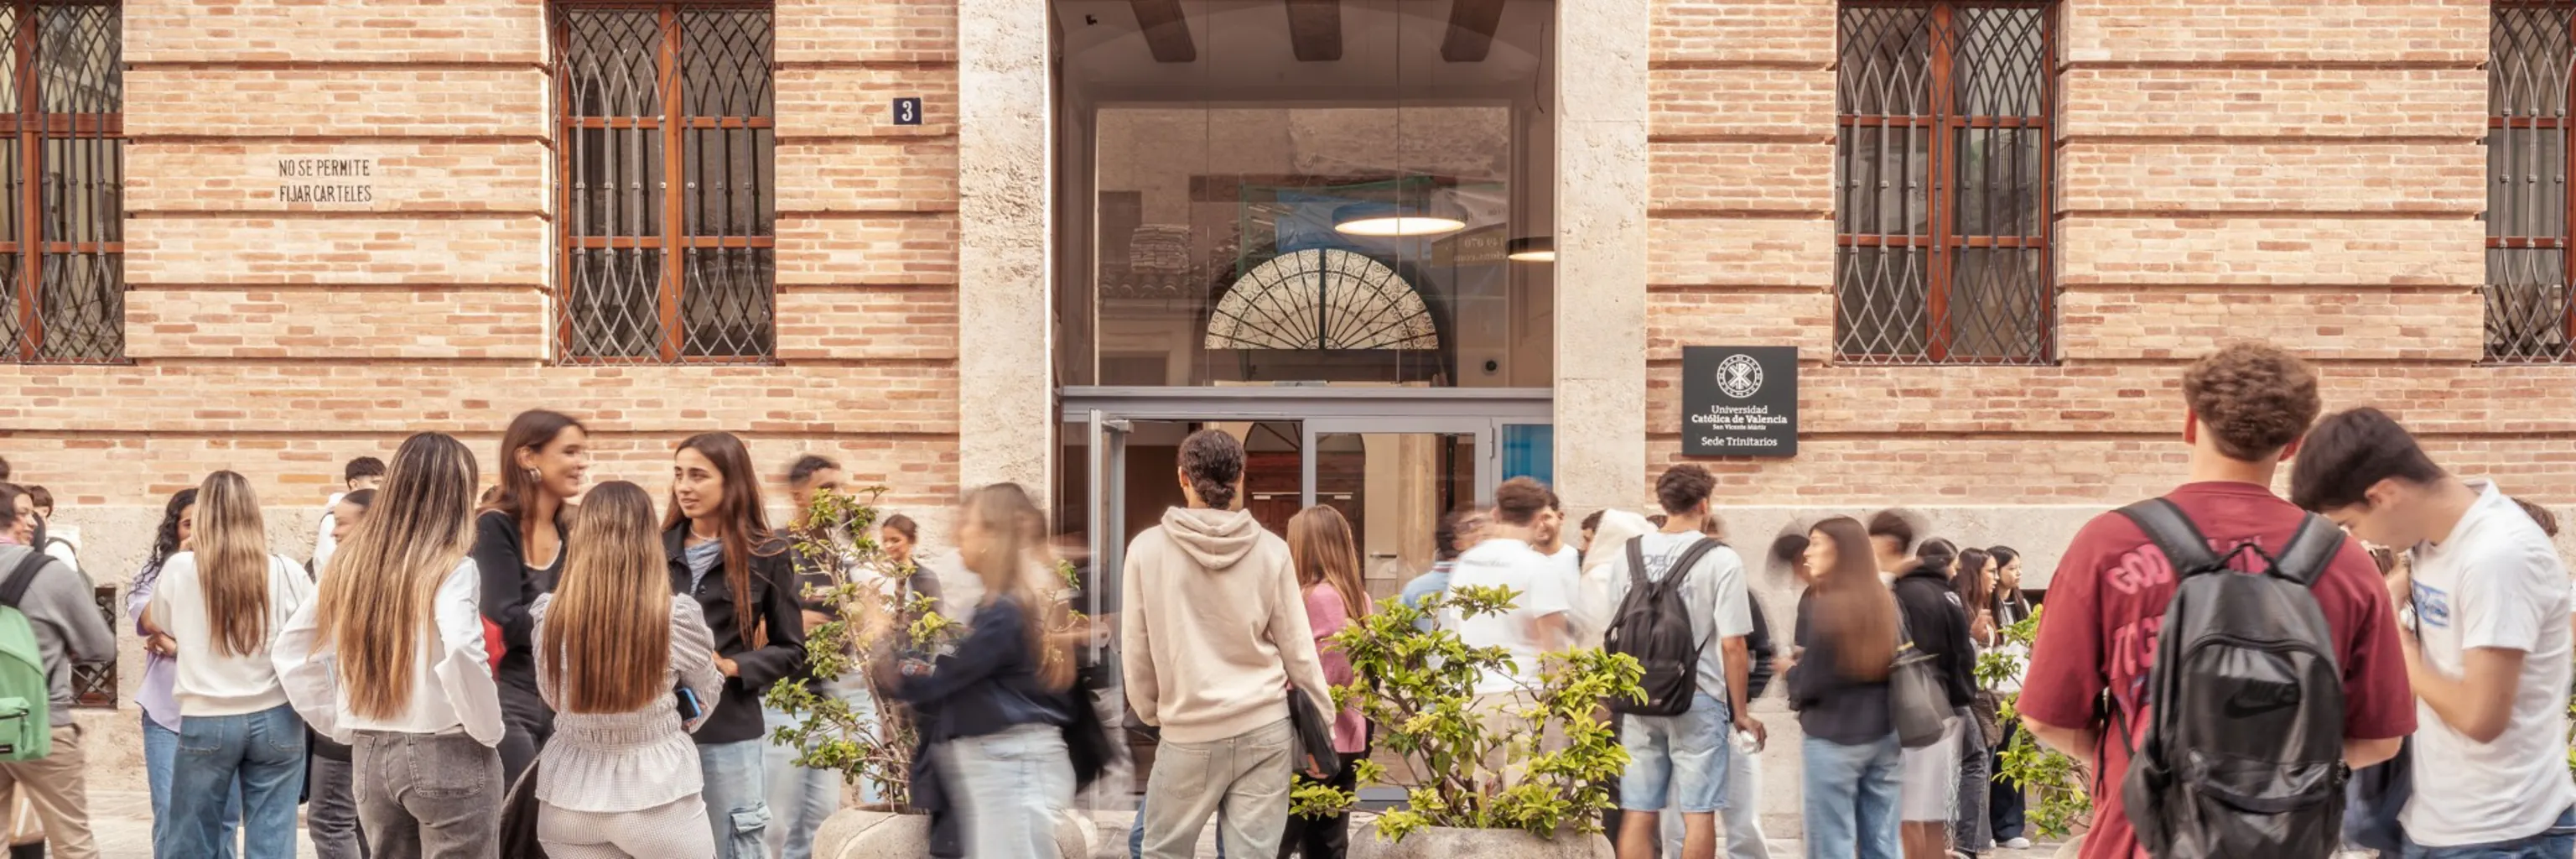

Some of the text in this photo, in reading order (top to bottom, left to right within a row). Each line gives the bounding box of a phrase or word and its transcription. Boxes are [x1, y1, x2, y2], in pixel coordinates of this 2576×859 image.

[901, 100, 913, 122] 3
[278, 159, 370, 177] NO SE PERMITE
[279, 185, 371, 202] FIJAR CARTELES
[1711, 405, 1768, 414] Universidad
[1691, 414, 1788, 424] Católica de Valencia
[1701, 436, 1778, 446] Sede Trinitarios
